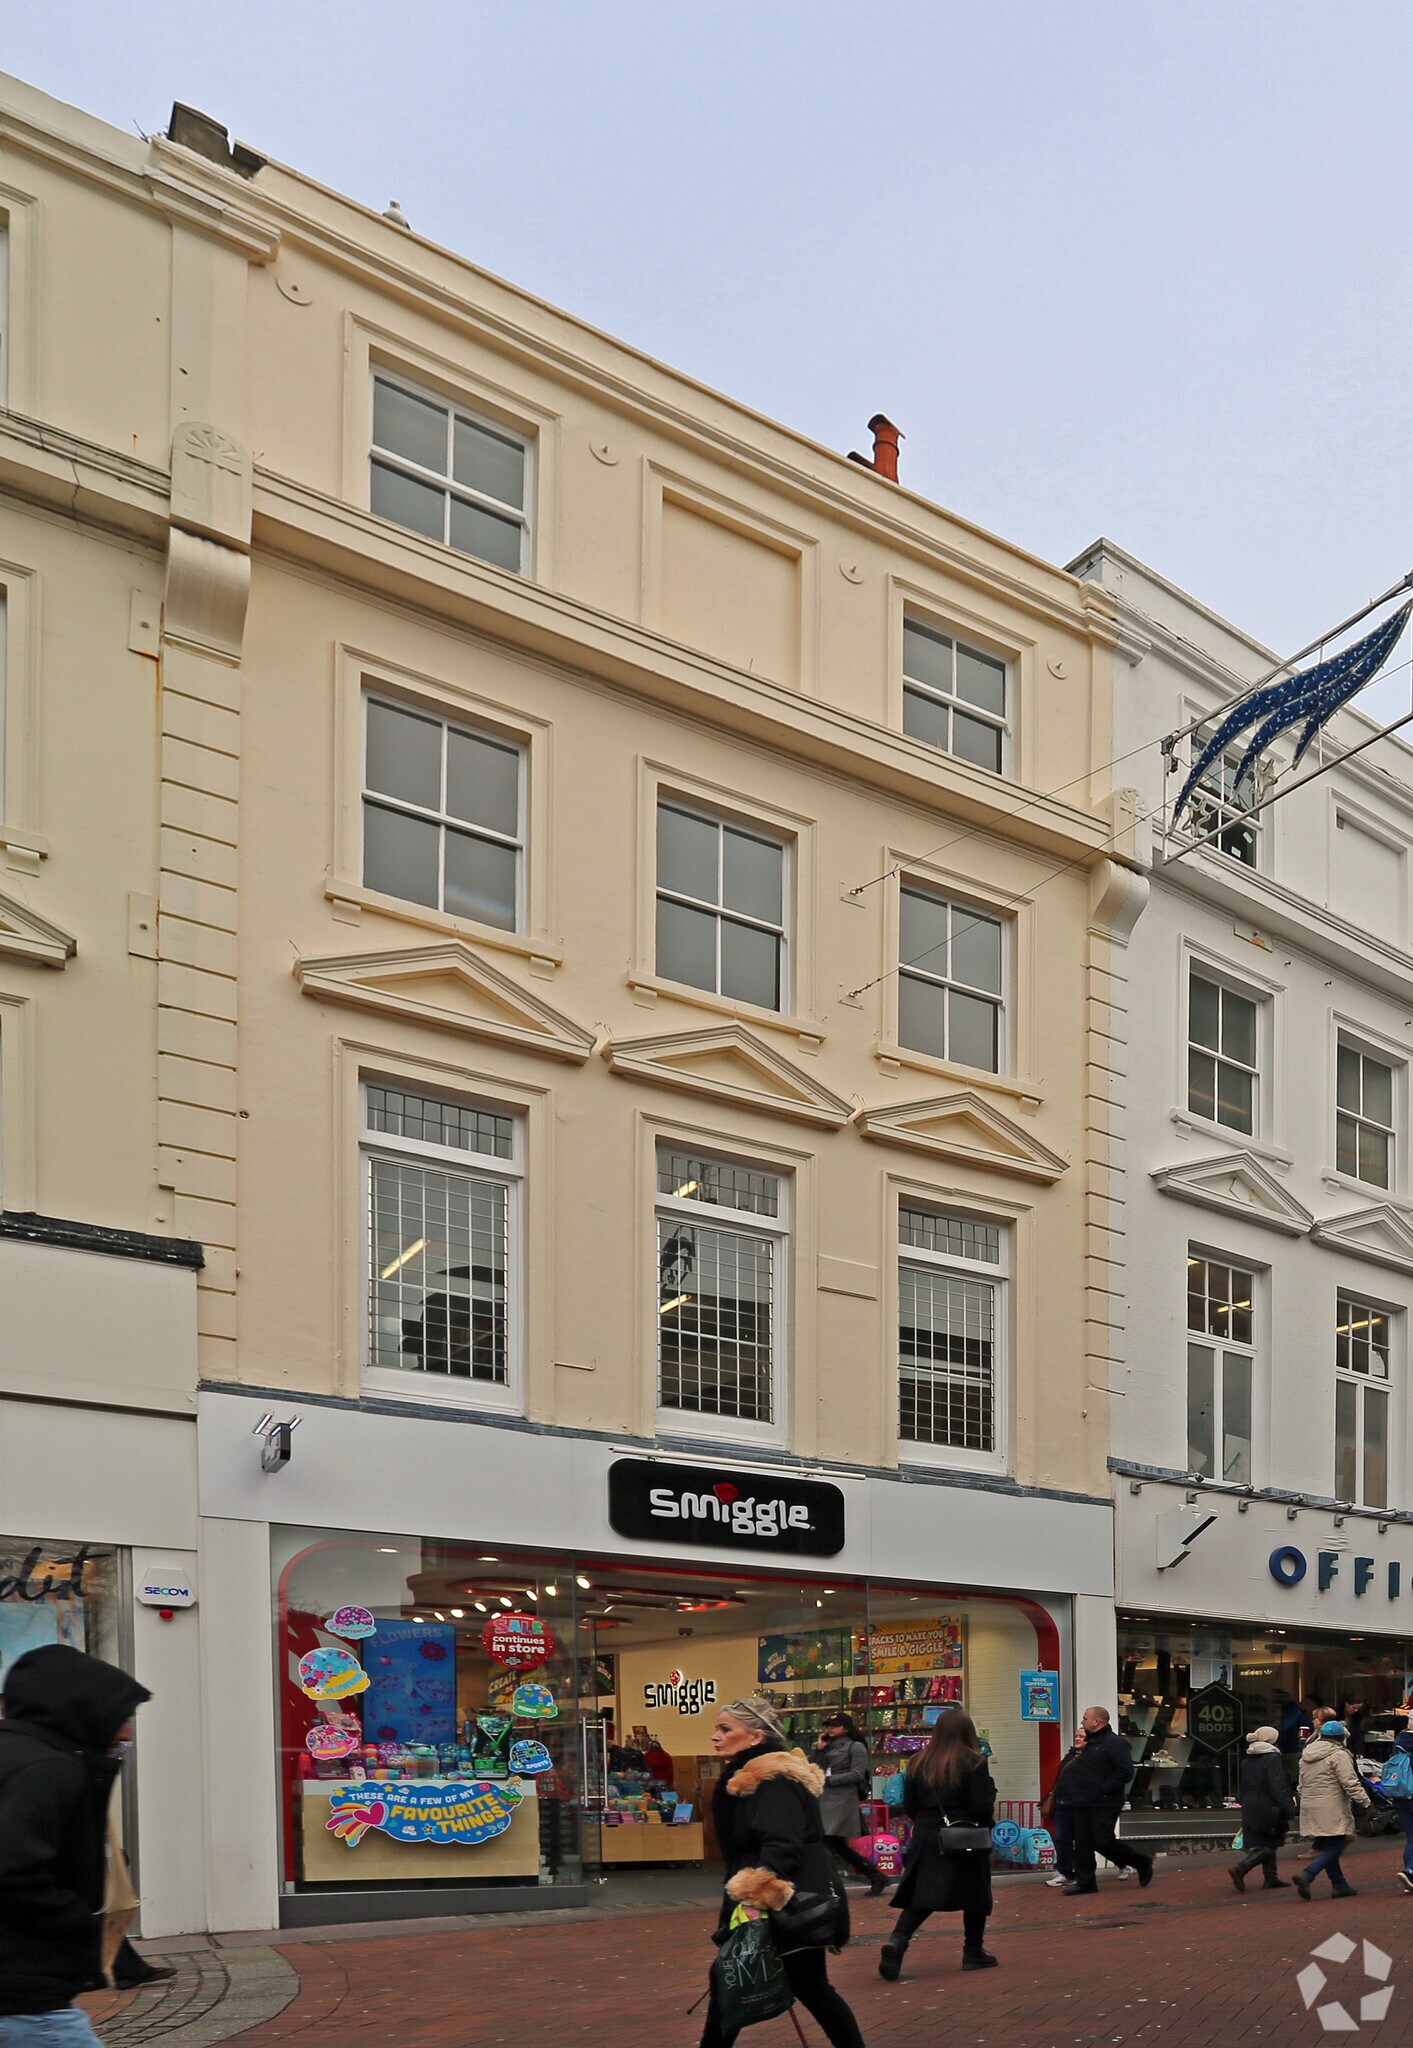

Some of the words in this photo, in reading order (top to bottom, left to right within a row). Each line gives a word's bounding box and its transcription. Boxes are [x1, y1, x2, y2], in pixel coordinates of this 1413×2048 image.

[650, 1483, 811, 1537] smiggle
[1268, 1545, 1413, 1600] OFFI
[144, 1586, 189, 1597] SECOM
[493, 1619, 545, 1636] SALE
[369, 1627, 443, 1648] FLOWERS
[492, 1635, 546, 1646] continues
[871, 1635, 895, 1646] PACKS
[895, 1633, 905, 1643] TO
[905, 1631, 927, 1642] MAKE
[928, 1629, 944, 1640] YOU
[492, 1641, 506, 1653] in
[508, 1643, 546, 1655] store
[871, 1646, 897, 1659] SMILE
[899, 1645, 907, 1656] &
[908, 1641, 944, 1655] GIGGLE
[325, 1671, 365, 1695] FLOWERS
[644, 1670, 716, 1715] smiggle
[1198, 1723, 1234, 1733] BOOTS
[525, 1760, 549, 1770] SPORTS
[348, 1792, 384, 1801] THESE
[386, 1794, 407, 1804] ARE
[409, 1797, 418, 1805] A
[420, 1797, 443, 1805] FEW
[445, 1794, 458, 1804] OF
[460, 1788, 477, 1800] MY
[390, 1792, 499, 1821] FAVOURITE
[436, 1805, 508, 1834] THINGS
[722, 1960, 737, 1990] YOUR
